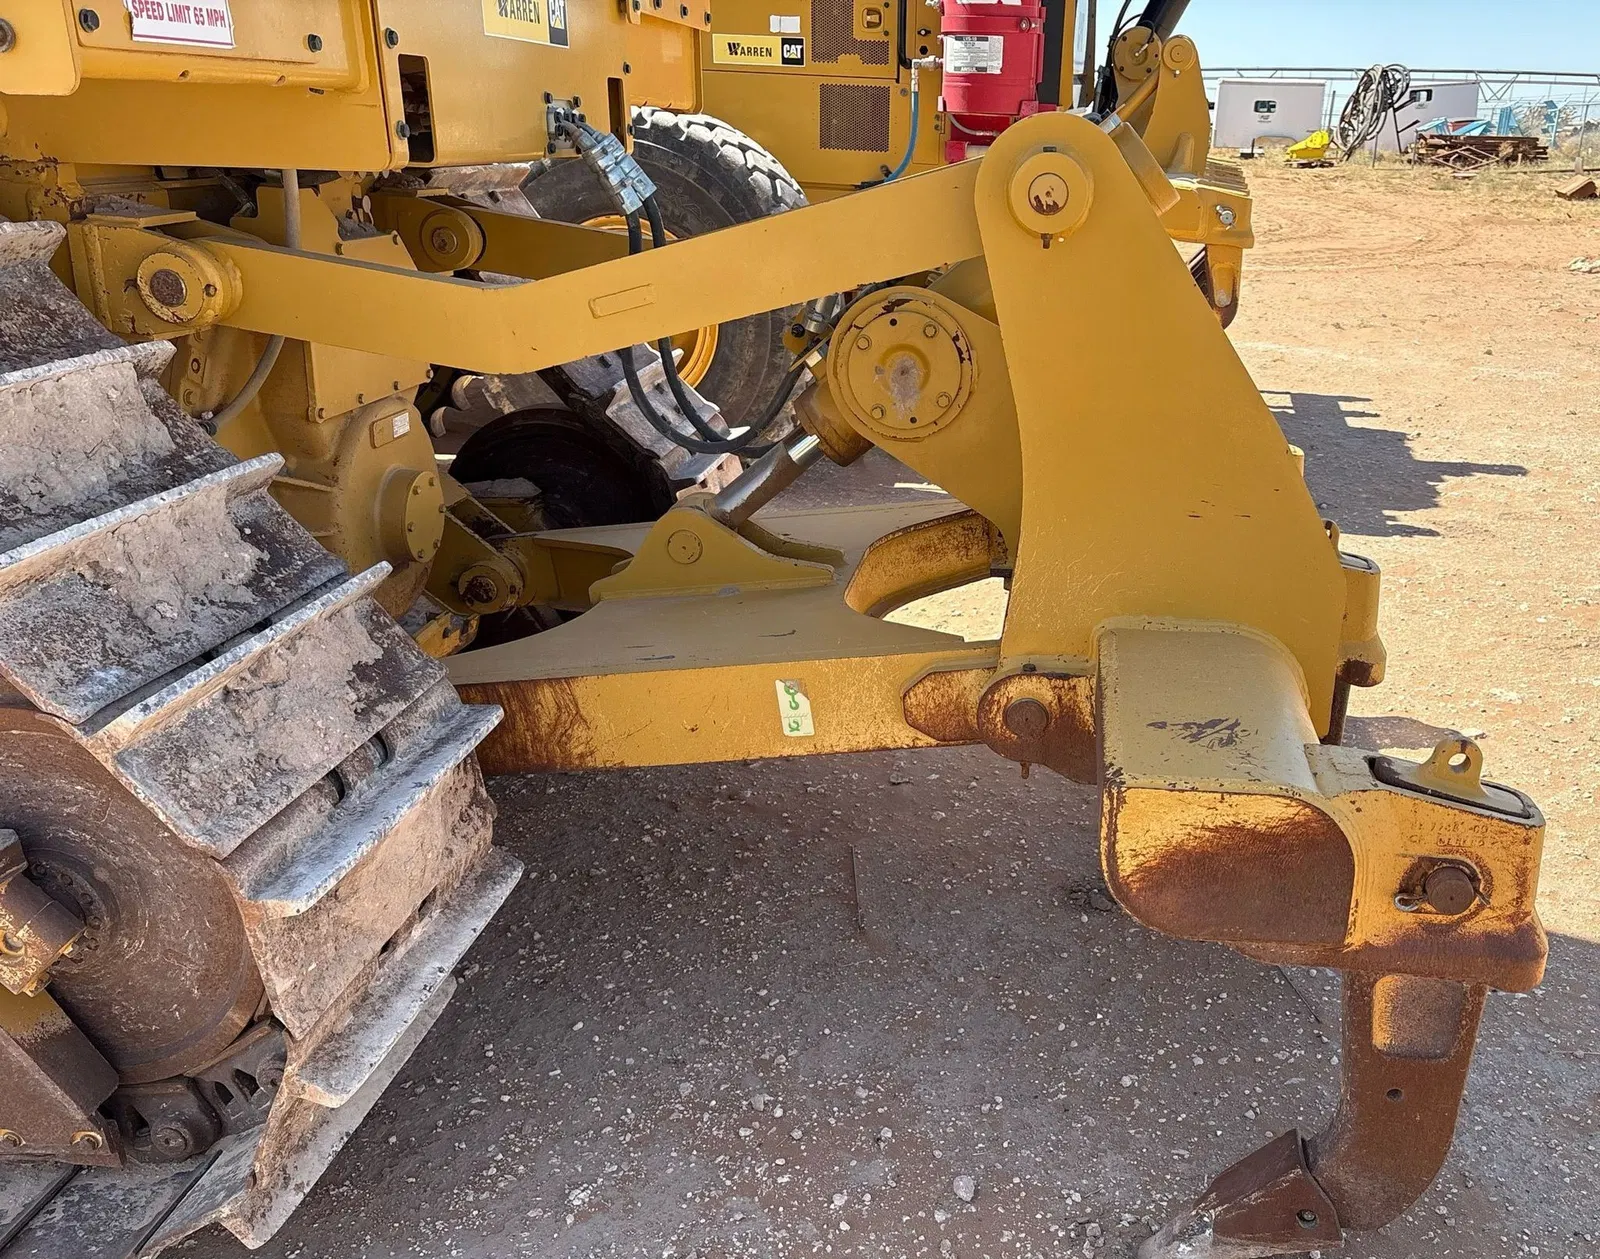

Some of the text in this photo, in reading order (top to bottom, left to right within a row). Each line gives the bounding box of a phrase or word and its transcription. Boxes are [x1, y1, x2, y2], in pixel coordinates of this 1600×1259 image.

[131, 0, 227, 28] SPEED LIMIT 65 MPH
[549, 0, 565, 29] CAT
[727, 42, 772, 57] WARREN
[783, 44, 802, 58] CAT
